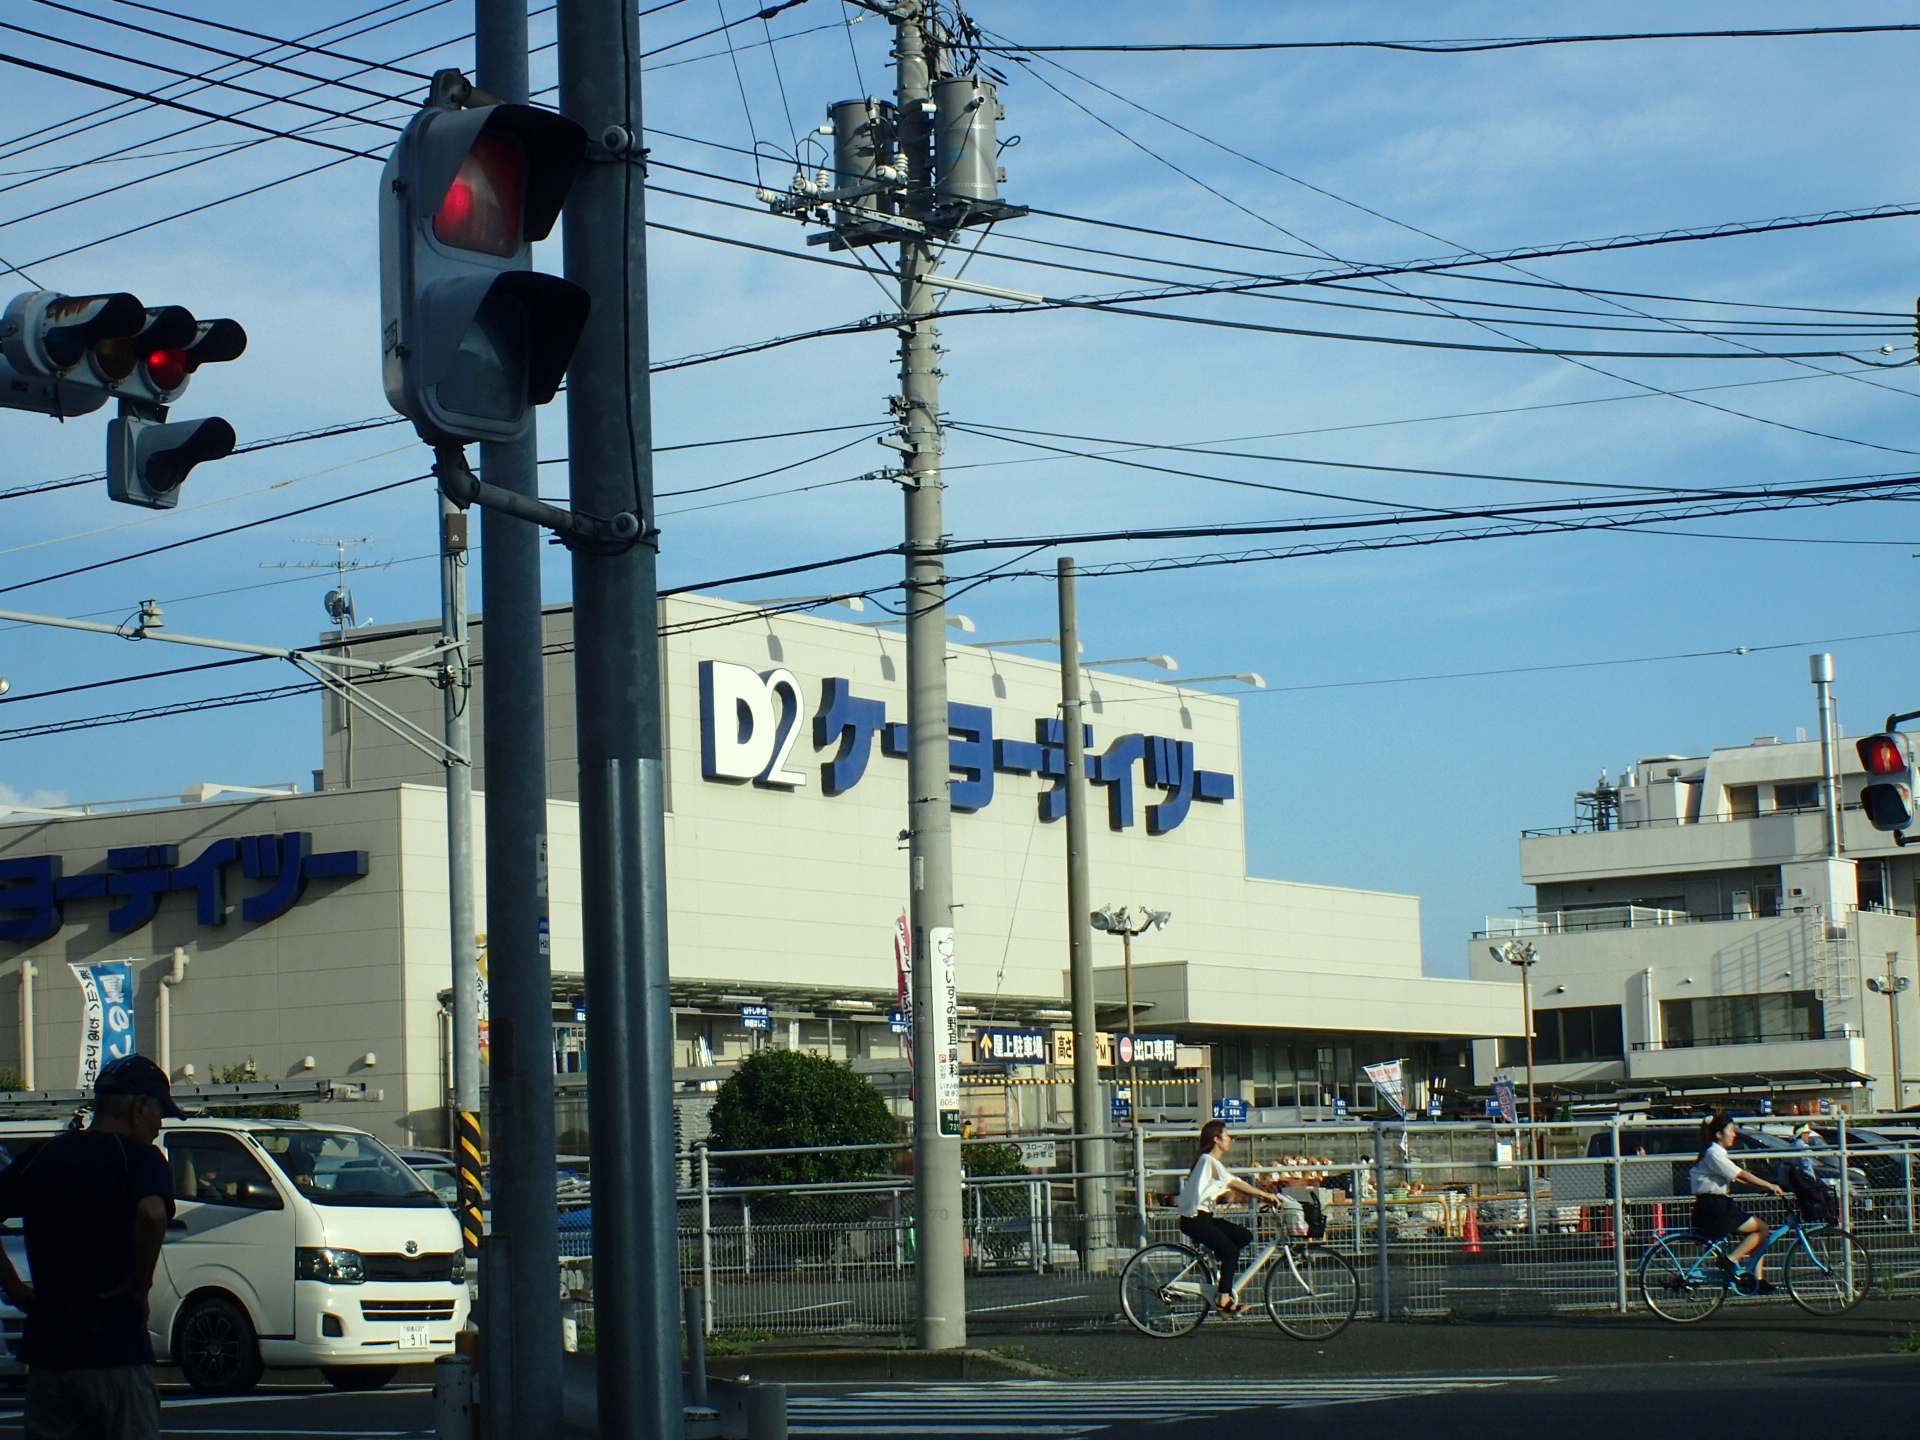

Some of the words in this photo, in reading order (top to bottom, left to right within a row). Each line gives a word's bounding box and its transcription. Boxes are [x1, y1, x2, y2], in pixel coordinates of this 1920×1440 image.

[700, 659, 807, 788] D2
[992, 1033, 1044, 1060] 屋上駐車場
[1133, 1038, 1176, 1062] 出口専用
